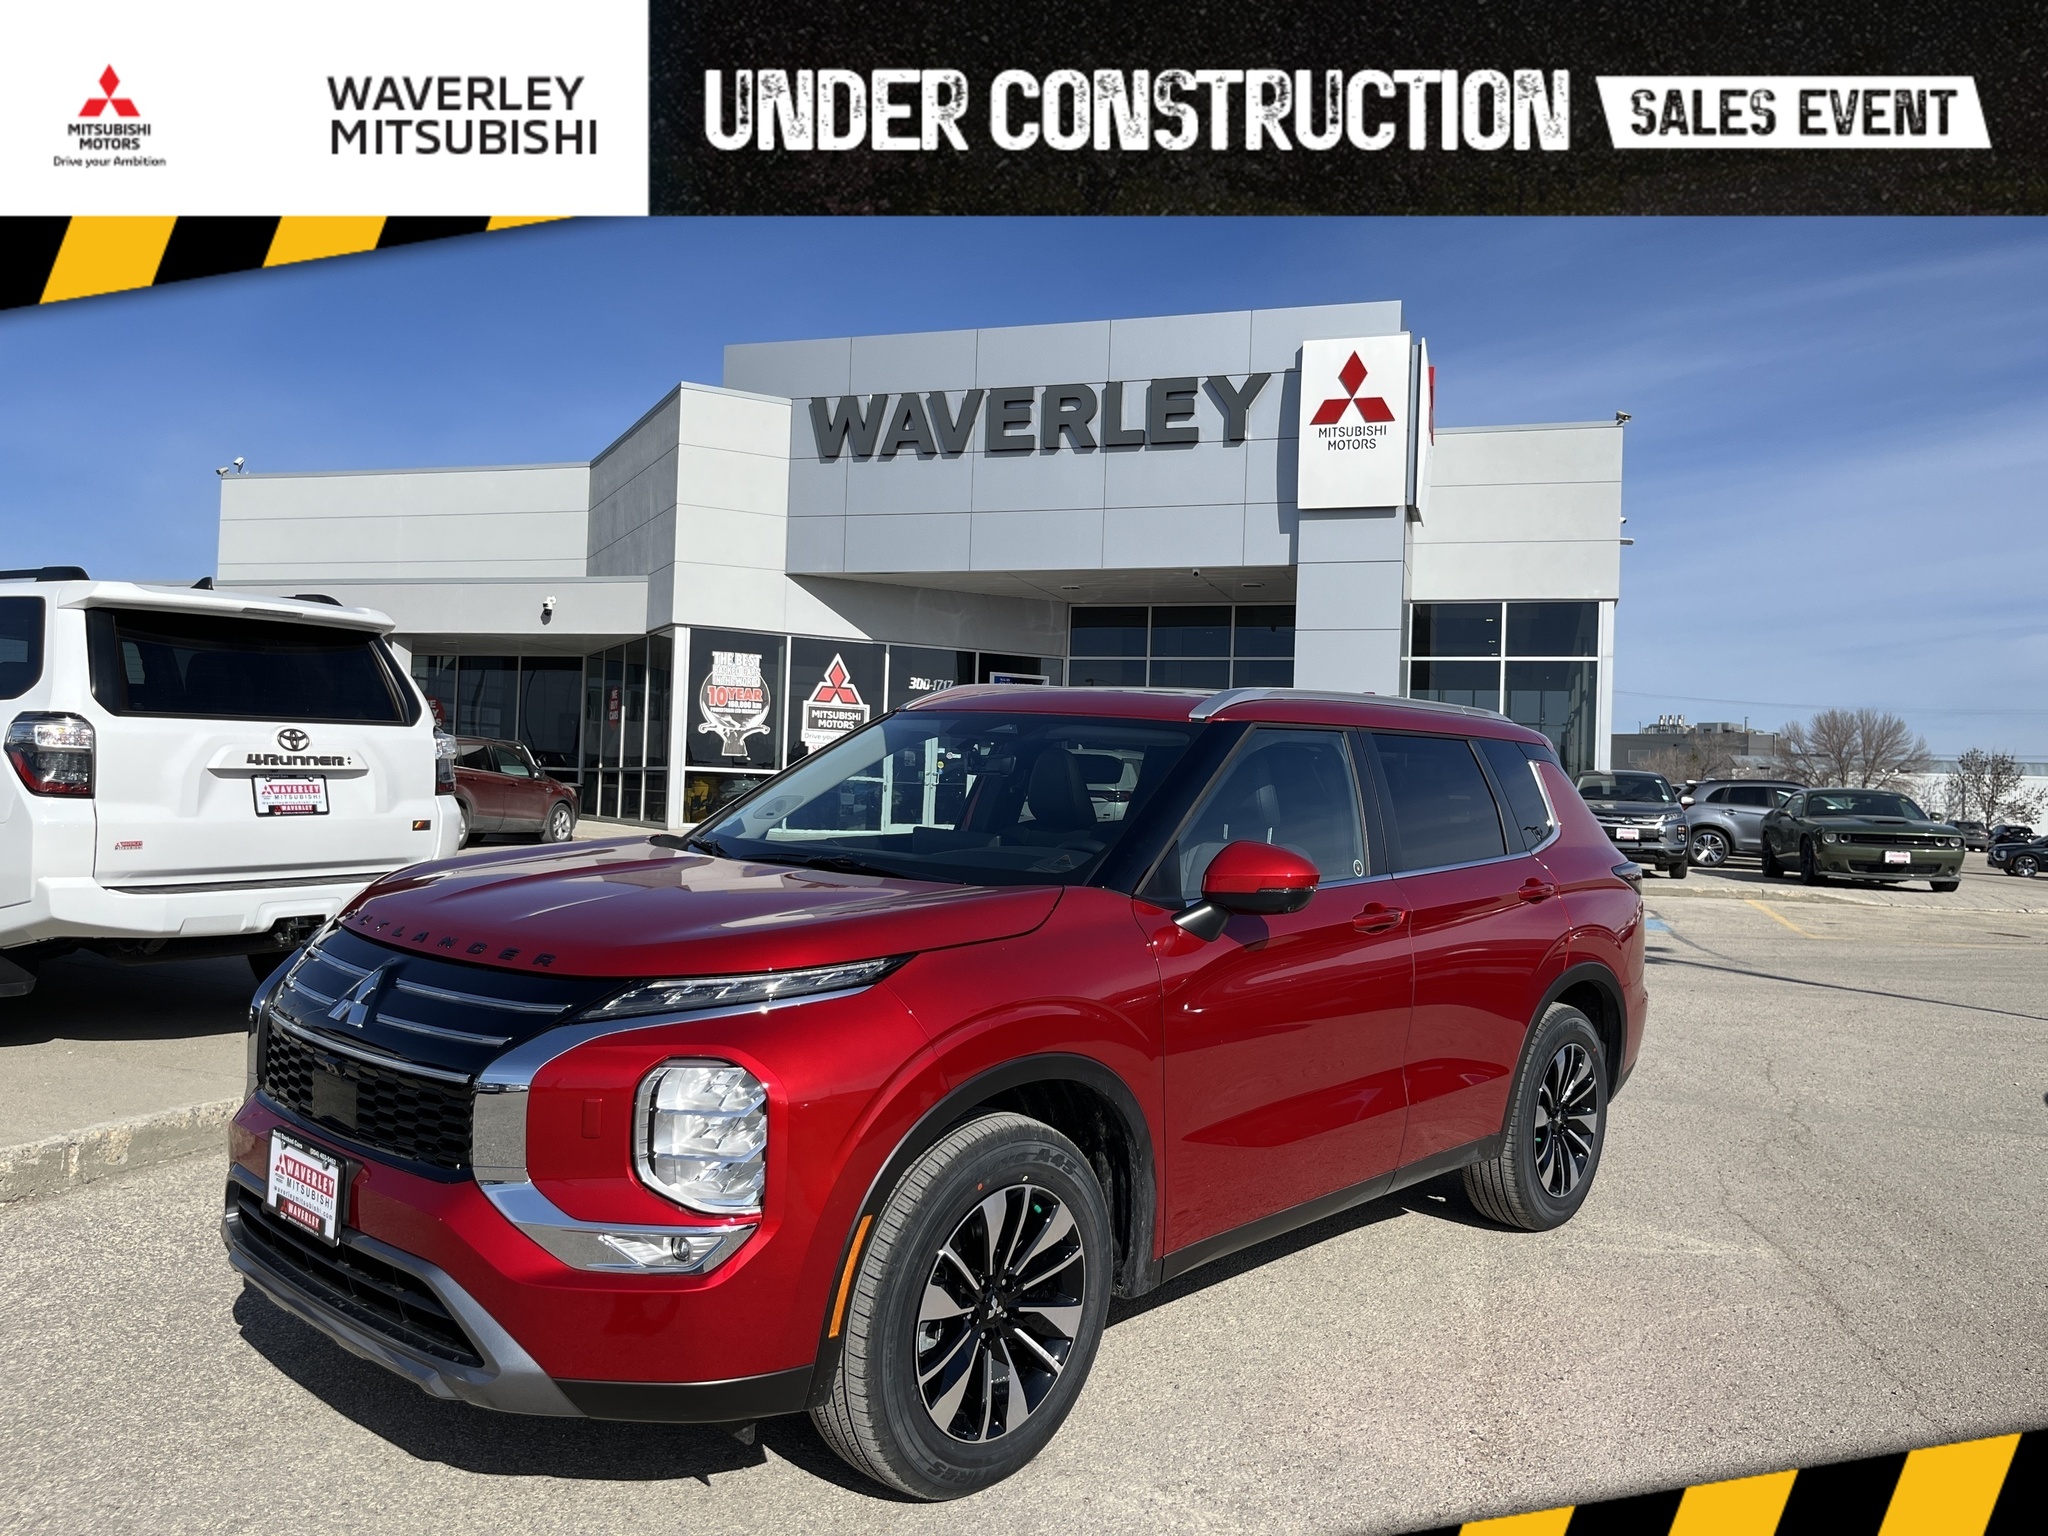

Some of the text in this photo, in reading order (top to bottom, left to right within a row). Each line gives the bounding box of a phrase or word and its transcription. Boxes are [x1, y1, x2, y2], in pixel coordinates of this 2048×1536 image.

[809, 373, 1271, 463] WAVERLEY
[1318, 425, 1387, 438] MITSUBISHI
[1327, 438, 1377, 451] MOTORS
[712, 651, 762, 667] THE BEST
[708, 685, 763, 707] 10 YEAR
[811, 709, 861, 721] MITSUBISHI
[818, 719, 854, 729] MOTORS
[272, 785, 320, 794] WAVERLEY
[345, 908, 557, 967] OUTLANDER
[287, 1158, 334, 1195] WAVERLEY
[286, 1177, 333, 1210] MITSUBISHI
[288, 1202, 320, 1228] WAVERLEY
